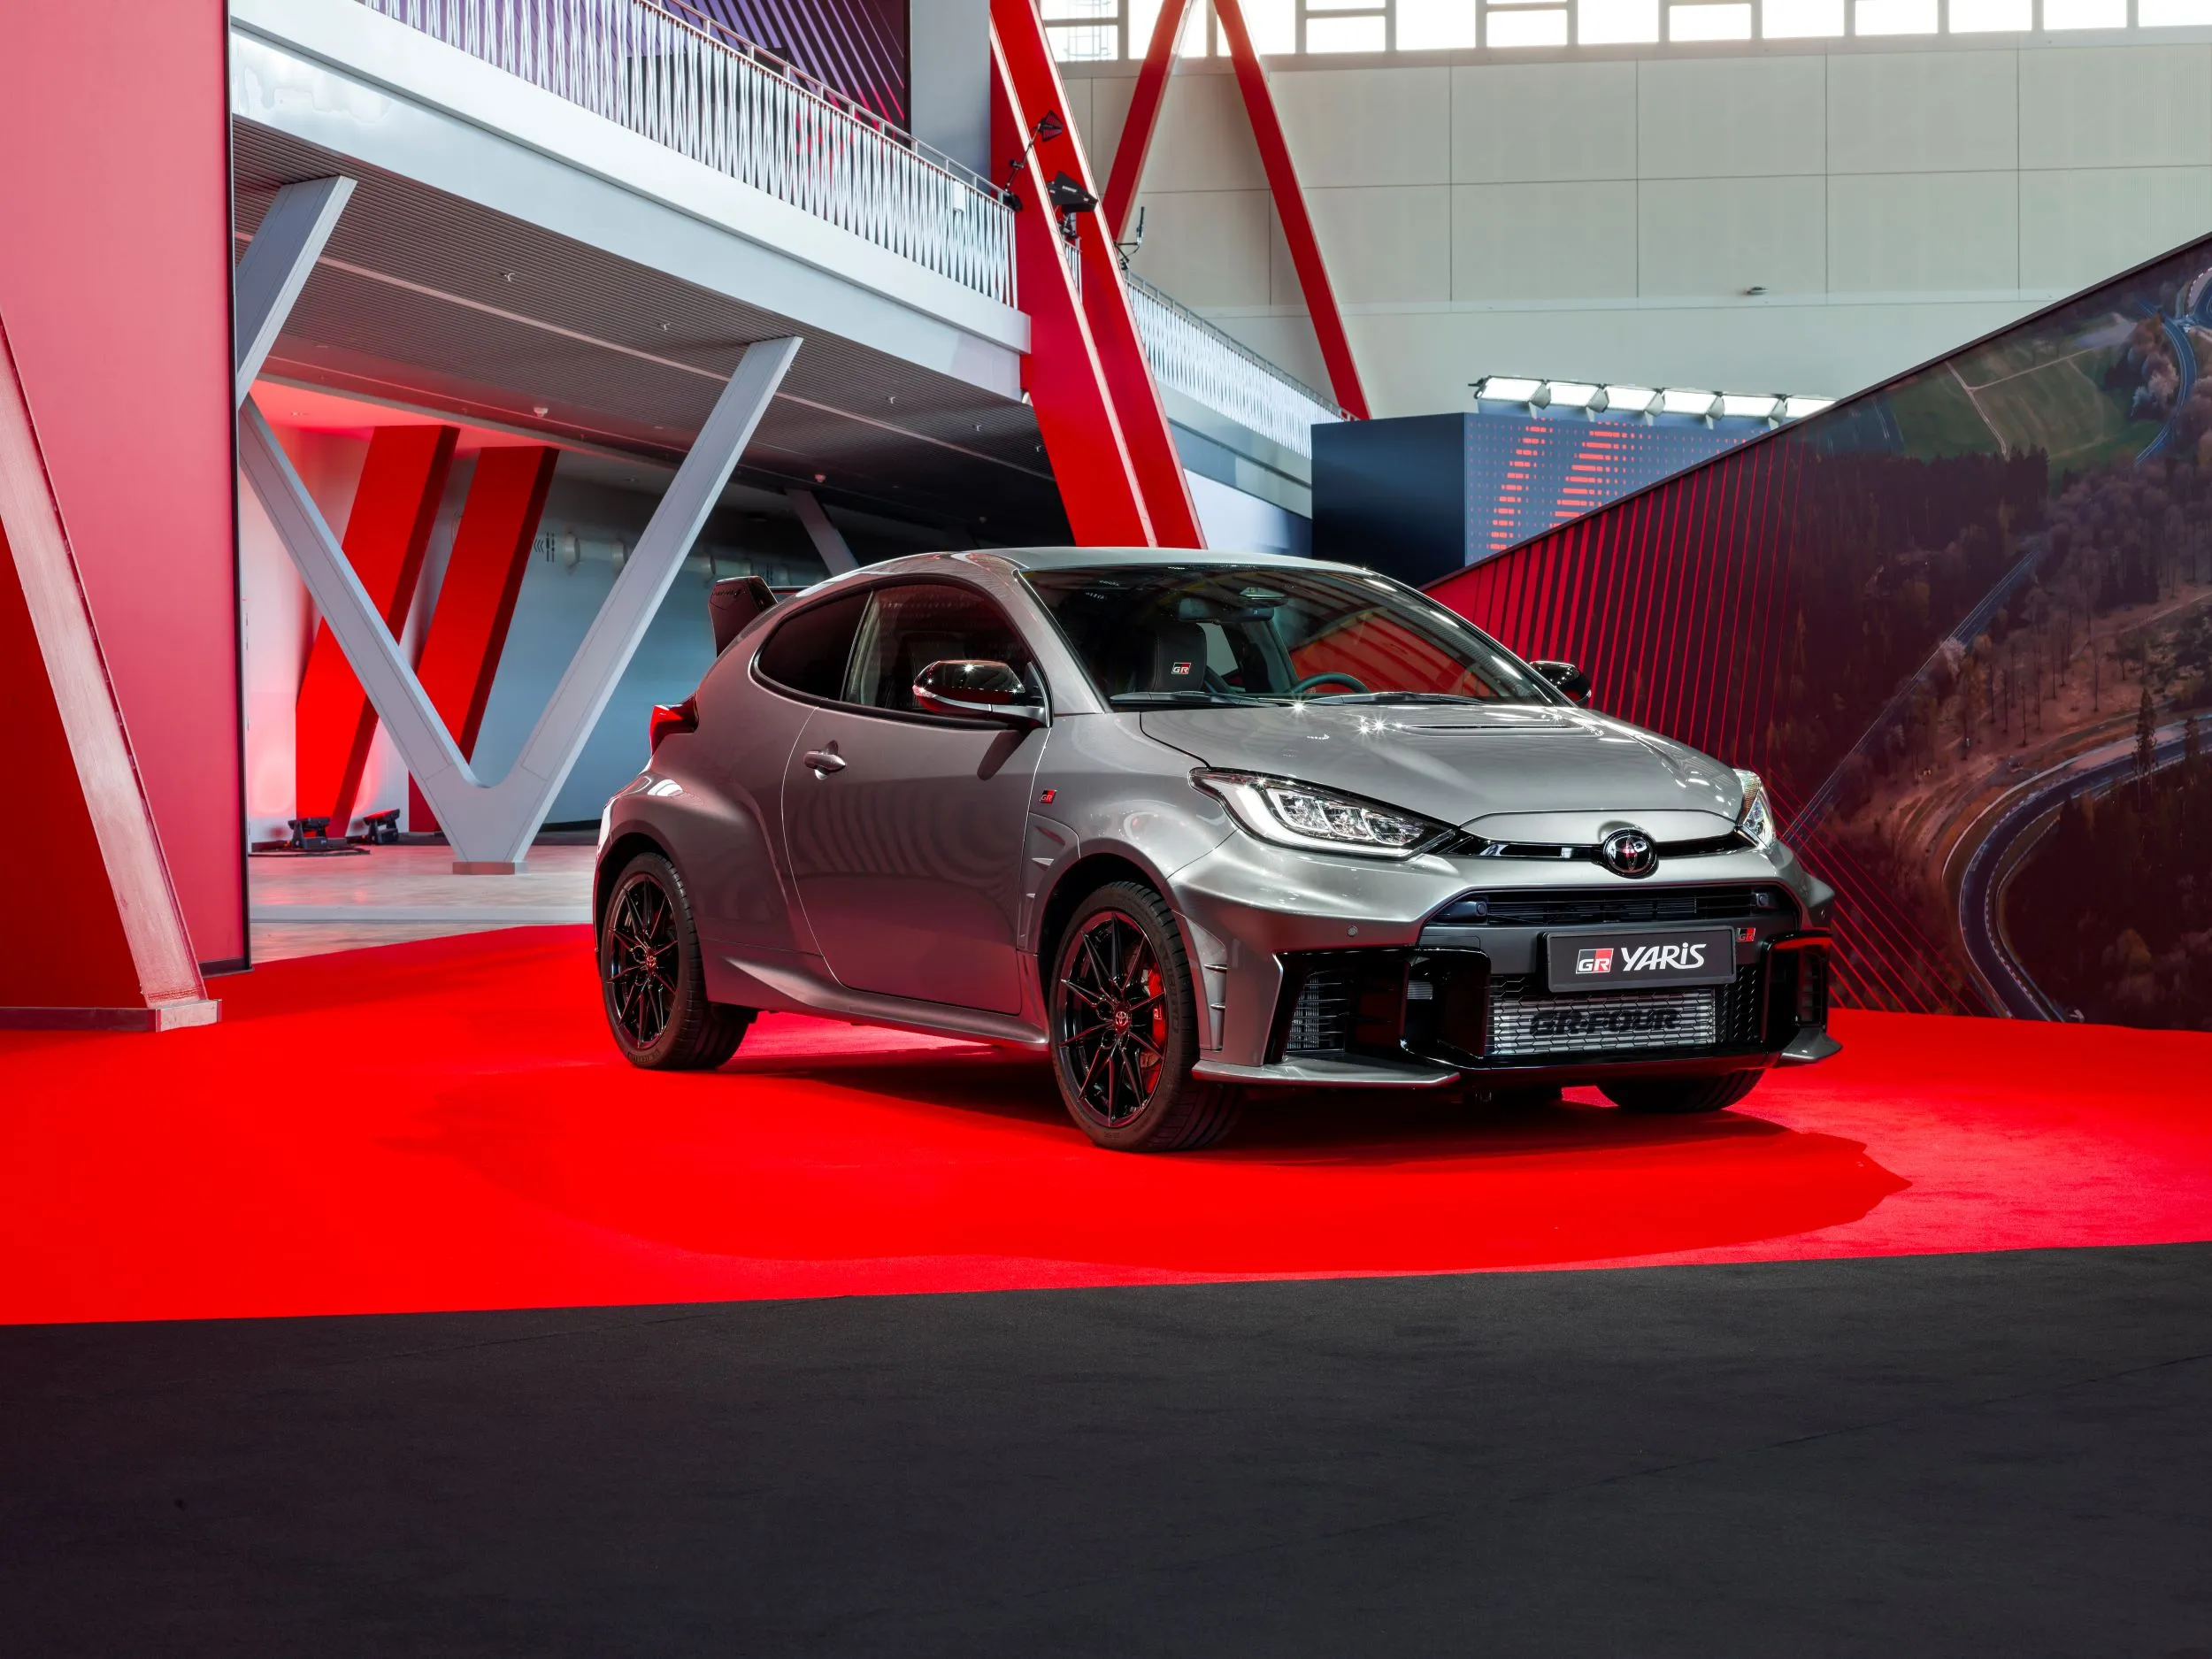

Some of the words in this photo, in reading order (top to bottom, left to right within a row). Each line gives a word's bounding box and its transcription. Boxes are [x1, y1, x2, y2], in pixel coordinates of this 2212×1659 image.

[1172, 665, 1190, 674] GR
[1041, 793, 1053, 803] GR
[1577, 957, 1611, 972] GR
